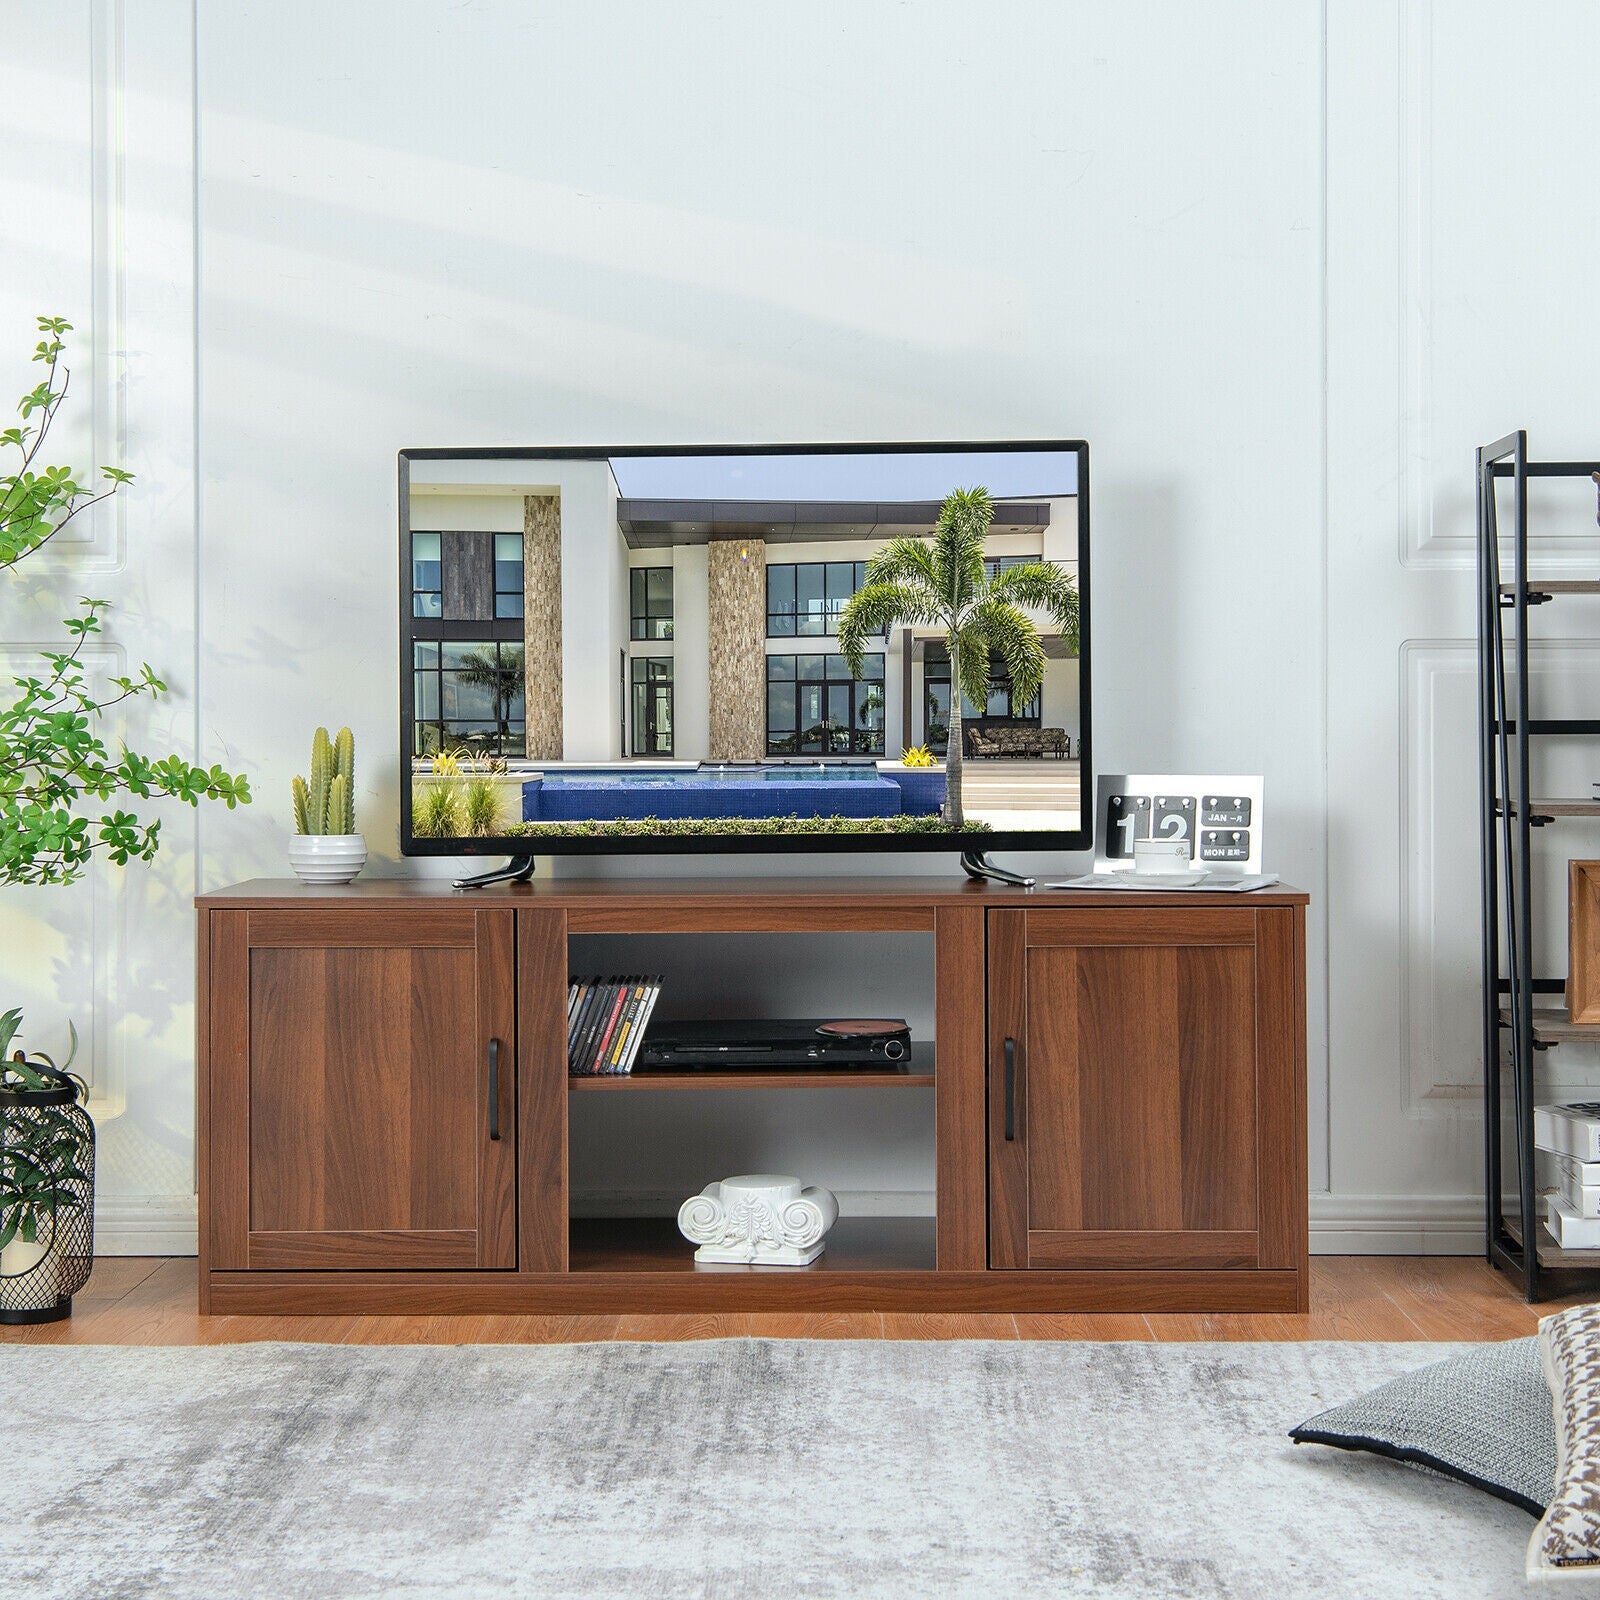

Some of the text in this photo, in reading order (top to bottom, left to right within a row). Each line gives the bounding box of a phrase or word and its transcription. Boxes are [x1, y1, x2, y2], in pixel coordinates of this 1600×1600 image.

[1208, 813, 1227, 822] JAN
[1117, 813, 1187, 853] 1 2
